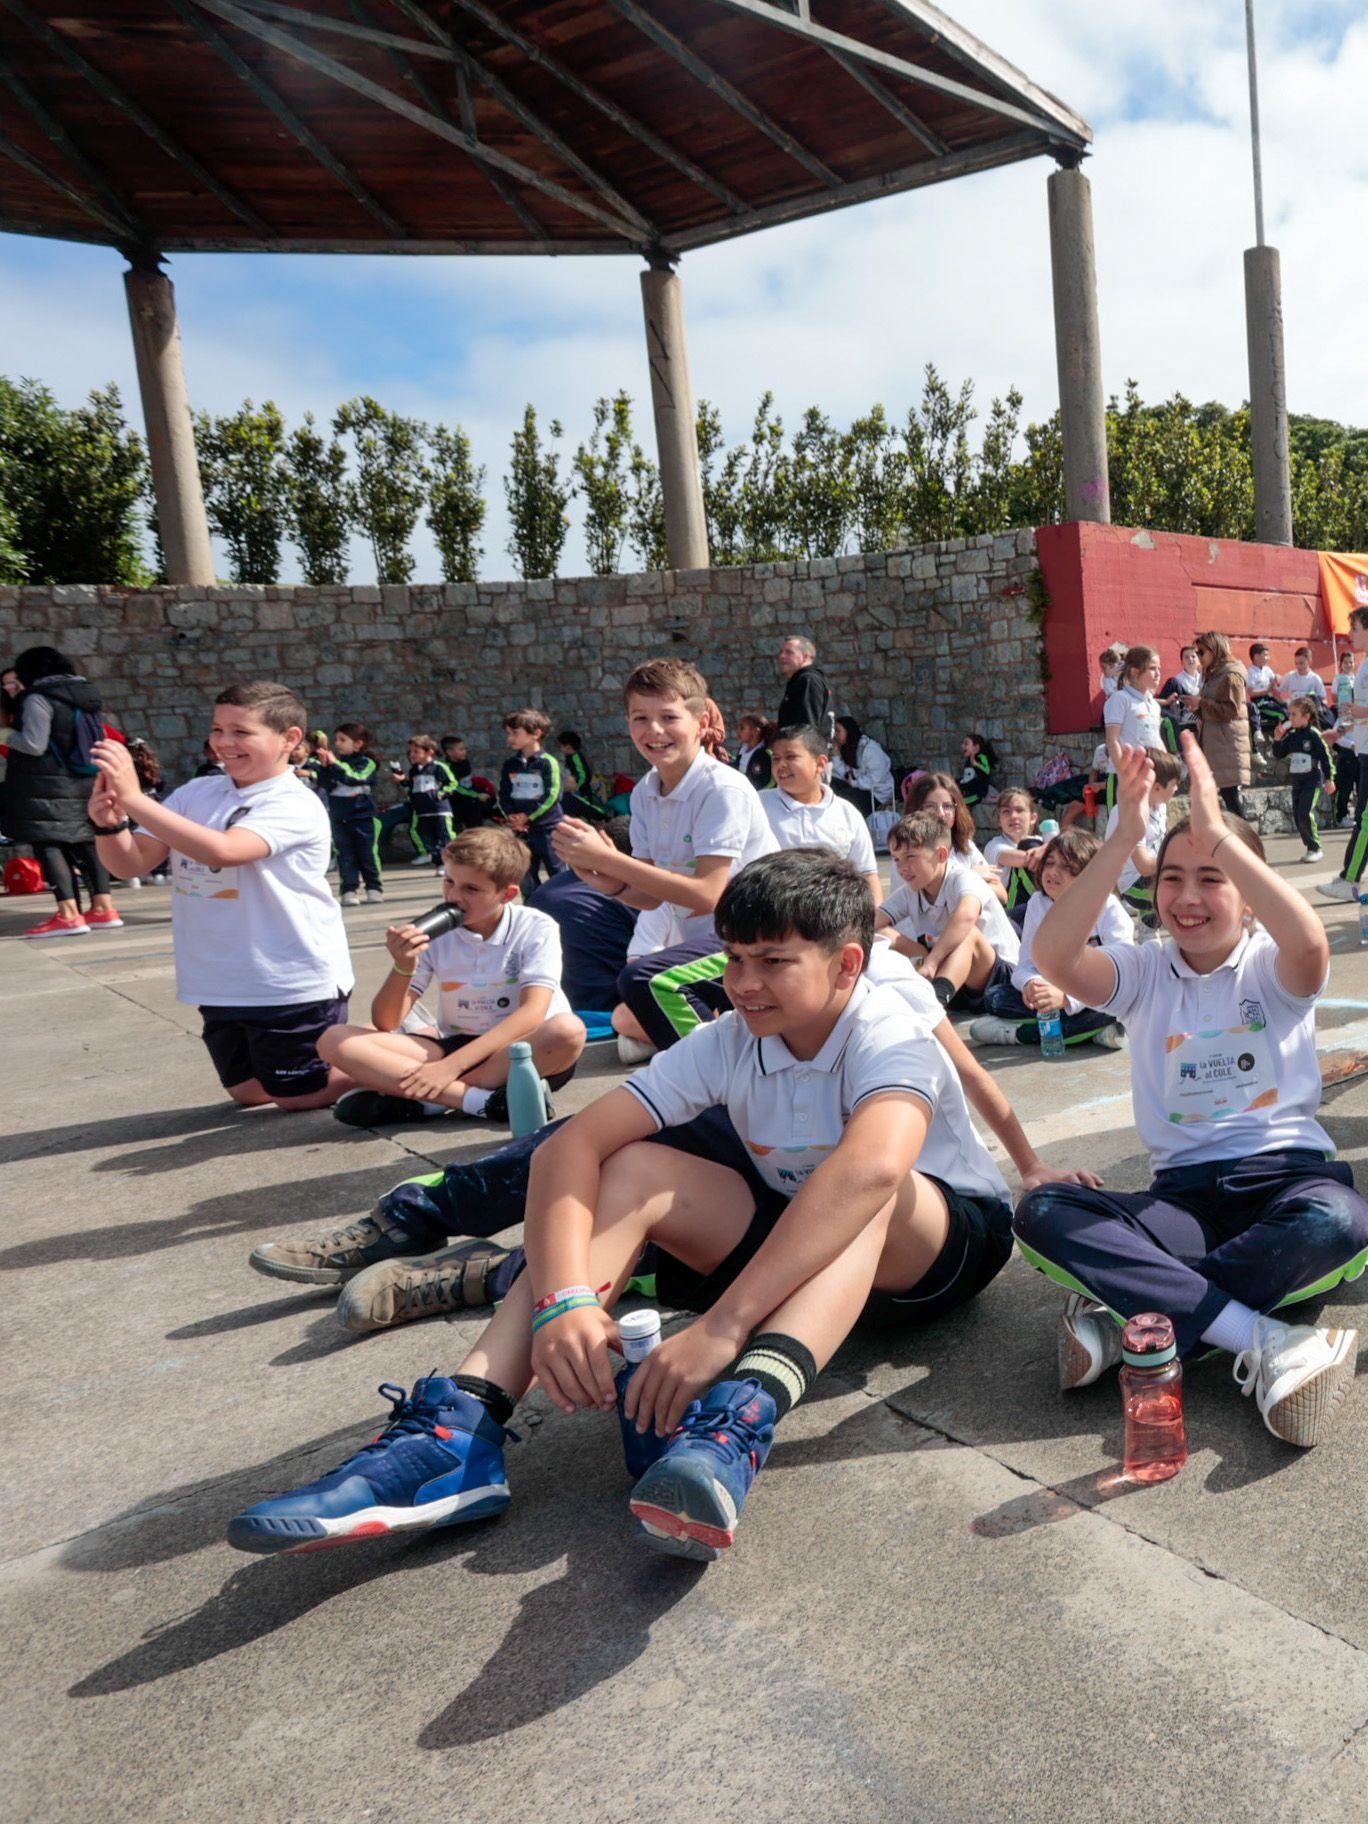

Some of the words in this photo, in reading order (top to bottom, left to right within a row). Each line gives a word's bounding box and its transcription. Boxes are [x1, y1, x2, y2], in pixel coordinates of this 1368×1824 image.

[1200, 1060, 1207, 1069] la
[1208, 1056, 1236, 1068] VUELTA
[1205, 1070, 1212, 1079] al
[1213, 1067, 1233, 1079] COLE
